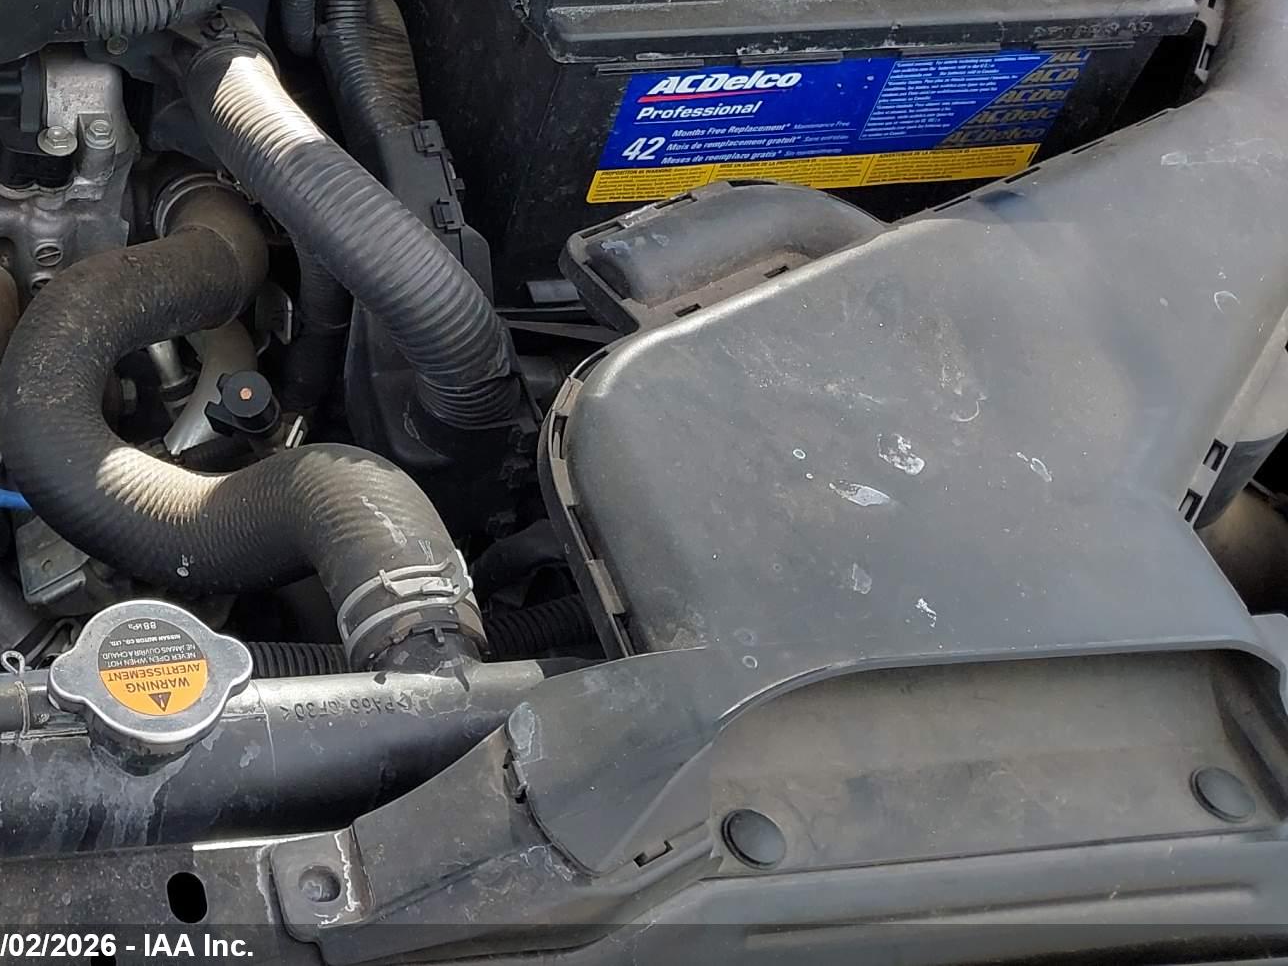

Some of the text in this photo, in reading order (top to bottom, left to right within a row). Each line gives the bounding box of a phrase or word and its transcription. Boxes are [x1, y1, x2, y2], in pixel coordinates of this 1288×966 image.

[646, 70, 803, 96] ACDelco
[636, 100, 763, 120] Professional
[672, 129, 705, 138] Months
[706, 126, 726, 135] Free
[621, 136, 666, 162] 42
[666, 143, 689, 152] Mois
[690, 141, 702, 150] de
[661, 156, 690, 165] Meses
[692, 154, 703, 163] de
[134, 648, 160, 656] OUVRIR
[172, 652, 196, 660] NEVER
[124, 657, 148, 666] WHEN
[149, 654, 170, 663] OPEN
[107, 663, 200, 682] AVERTISSEMENT
[125, 677, 190, 693] WARNING
